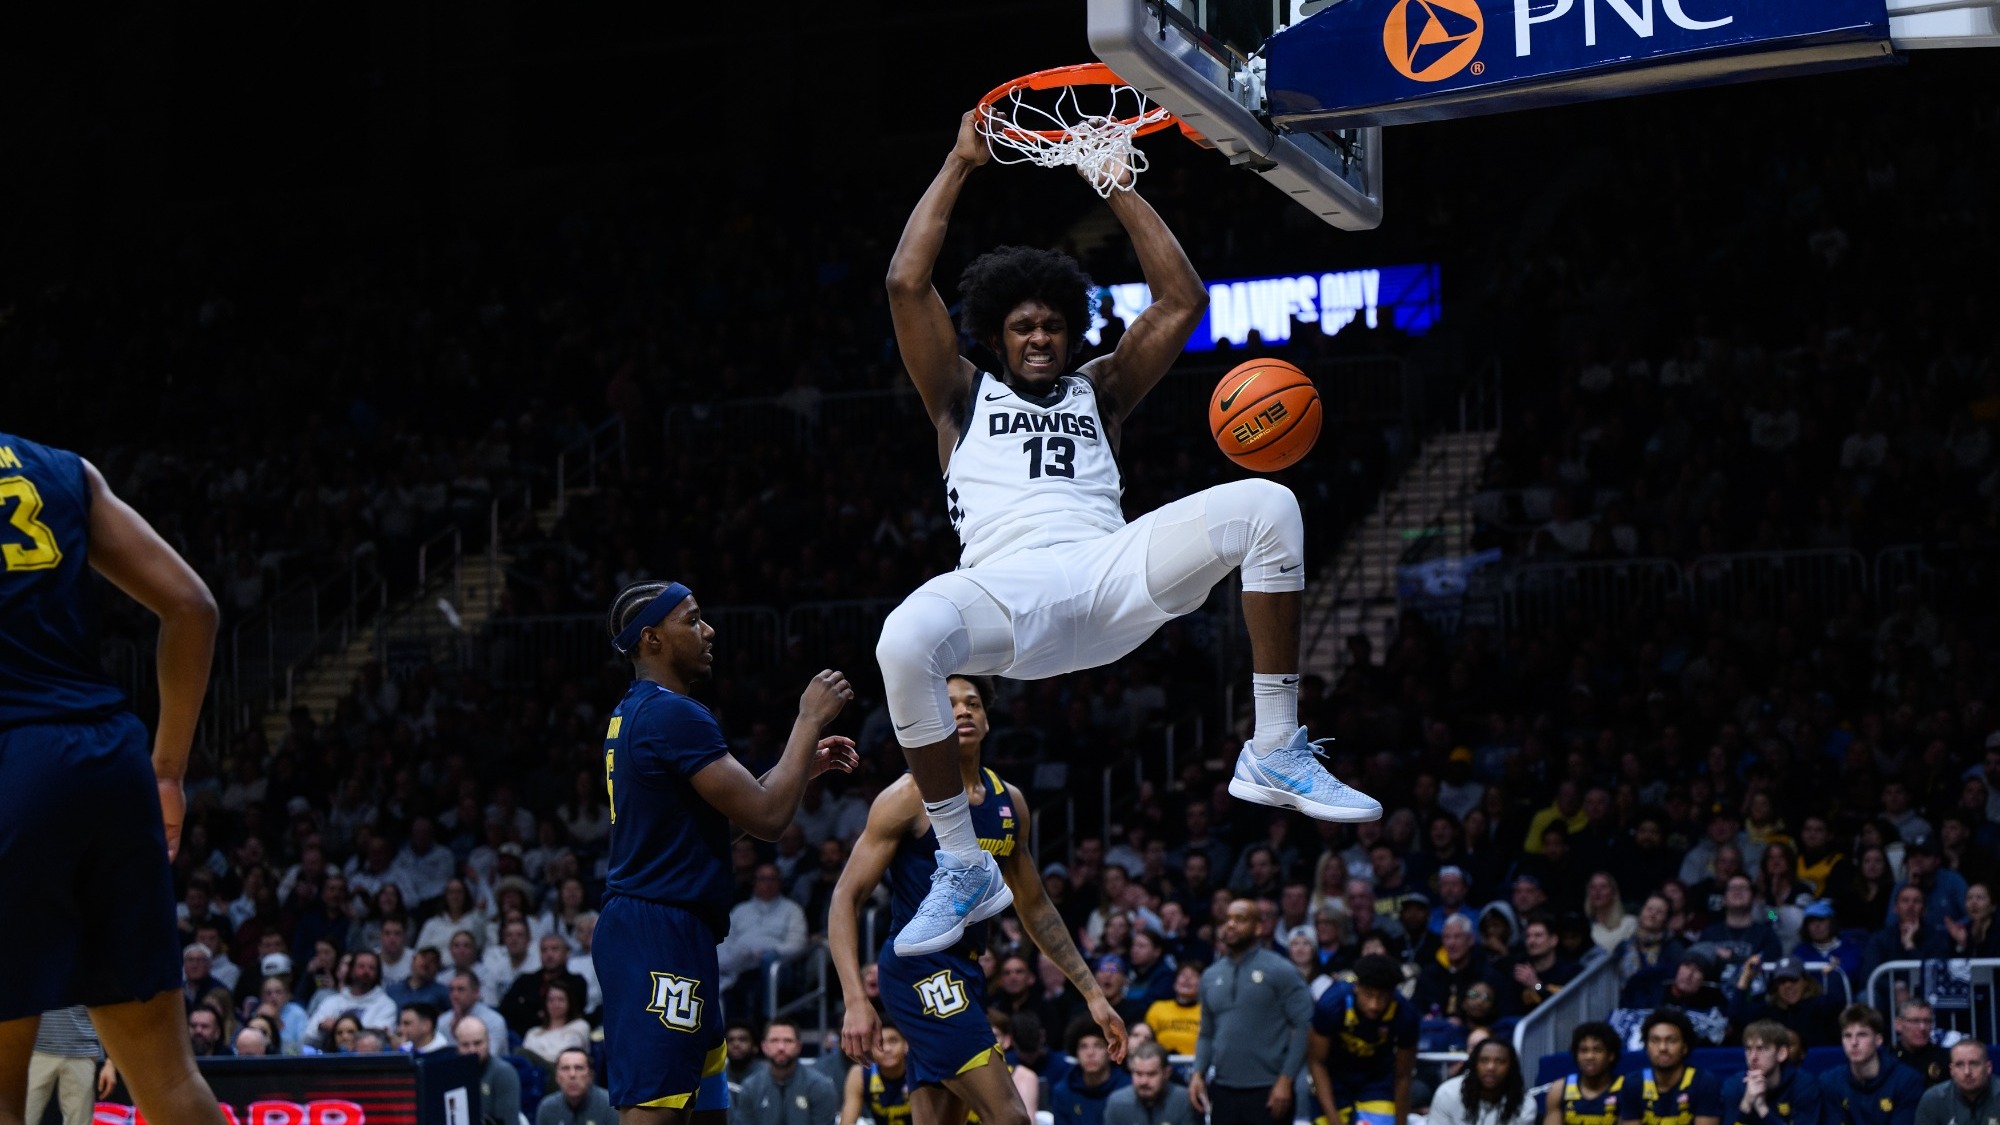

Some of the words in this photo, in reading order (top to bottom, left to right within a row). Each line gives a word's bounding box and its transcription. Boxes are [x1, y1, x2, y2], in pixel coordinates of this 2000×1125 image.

[989, 412, 1098, 440] DAWGS
[1231, 400, 1289, 444] ELITE
[1023, 436, 1076, 480] 13
[650, 975, 702, 1030] MU
[916, 972, 967, 1016] MU
